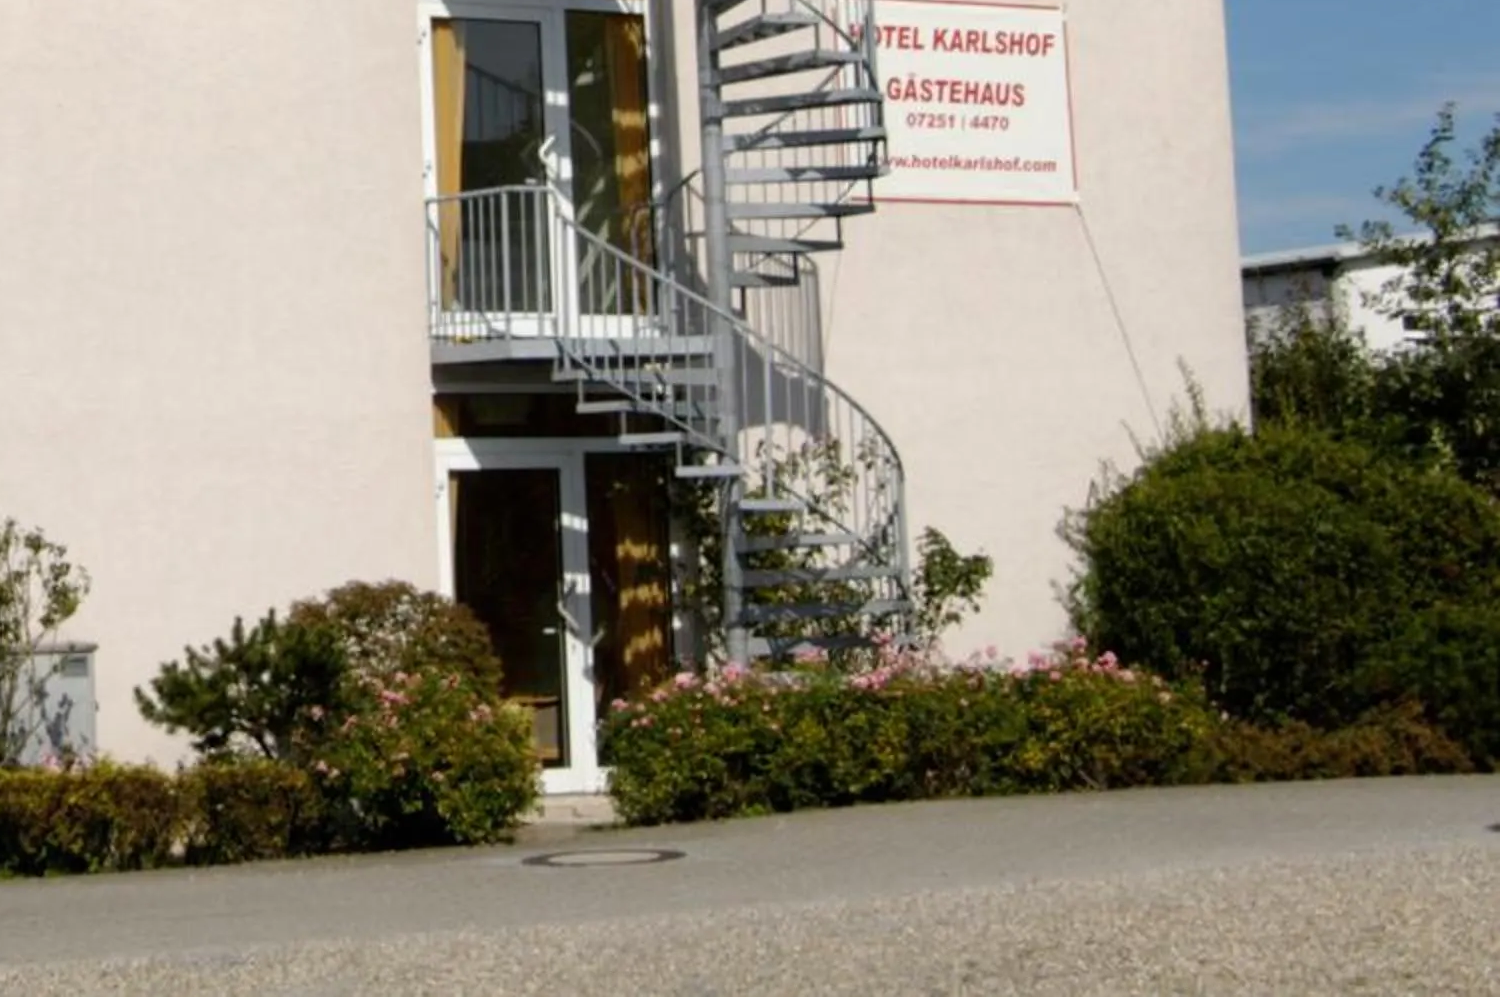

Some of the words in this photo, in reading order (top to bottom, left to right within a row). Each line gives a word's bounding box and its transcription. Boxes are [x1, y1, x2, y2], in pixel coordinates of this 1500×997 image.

[932, 28, 1055, 56] KARLSHOF
[886, 73, 1025, 107] GÄSTEHAUS
[906, 112, 955, 130] 07251
[970, 114, 1009, 131] 4470
[878, 154, 1057, 172] ww.hotelkarlshof.com
